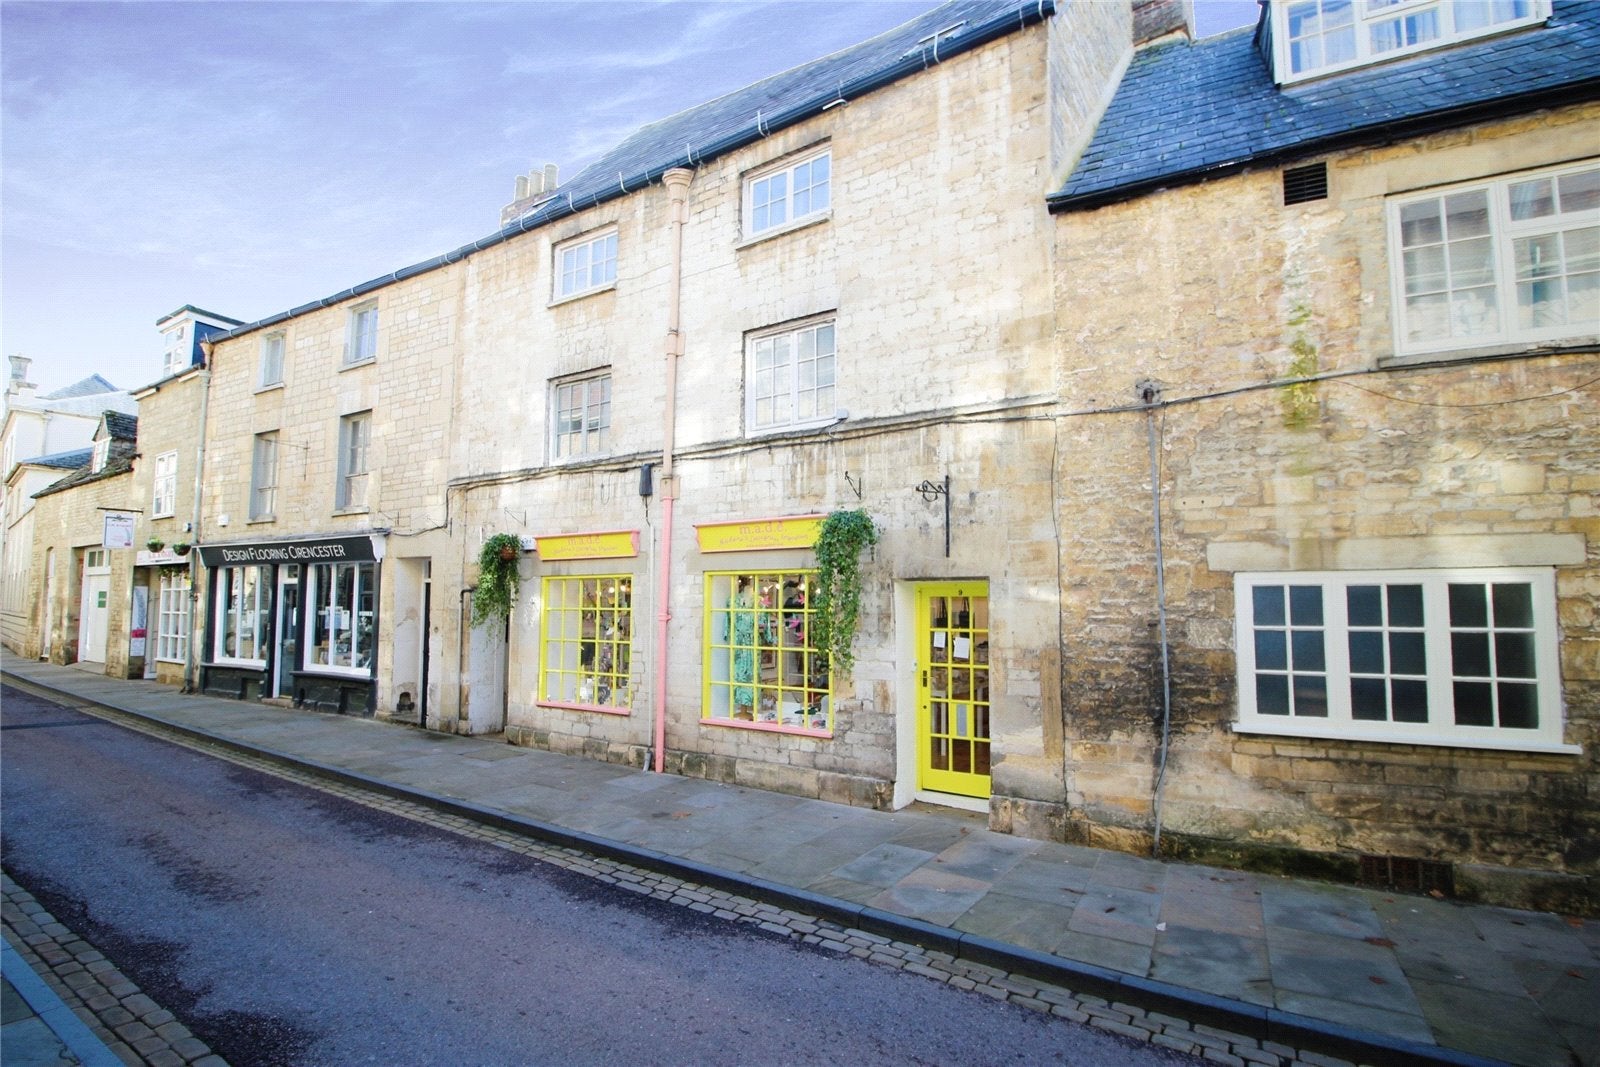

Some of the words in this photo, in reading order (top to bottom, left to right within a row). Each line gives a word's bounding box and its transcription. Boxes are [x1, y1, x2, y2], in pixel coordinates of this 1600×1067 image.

[222, 548, 250, 562] DESIGN
[250, 547, 289, 560] FLOORING
[289, 544, 345, 559] CIRENCESTER
